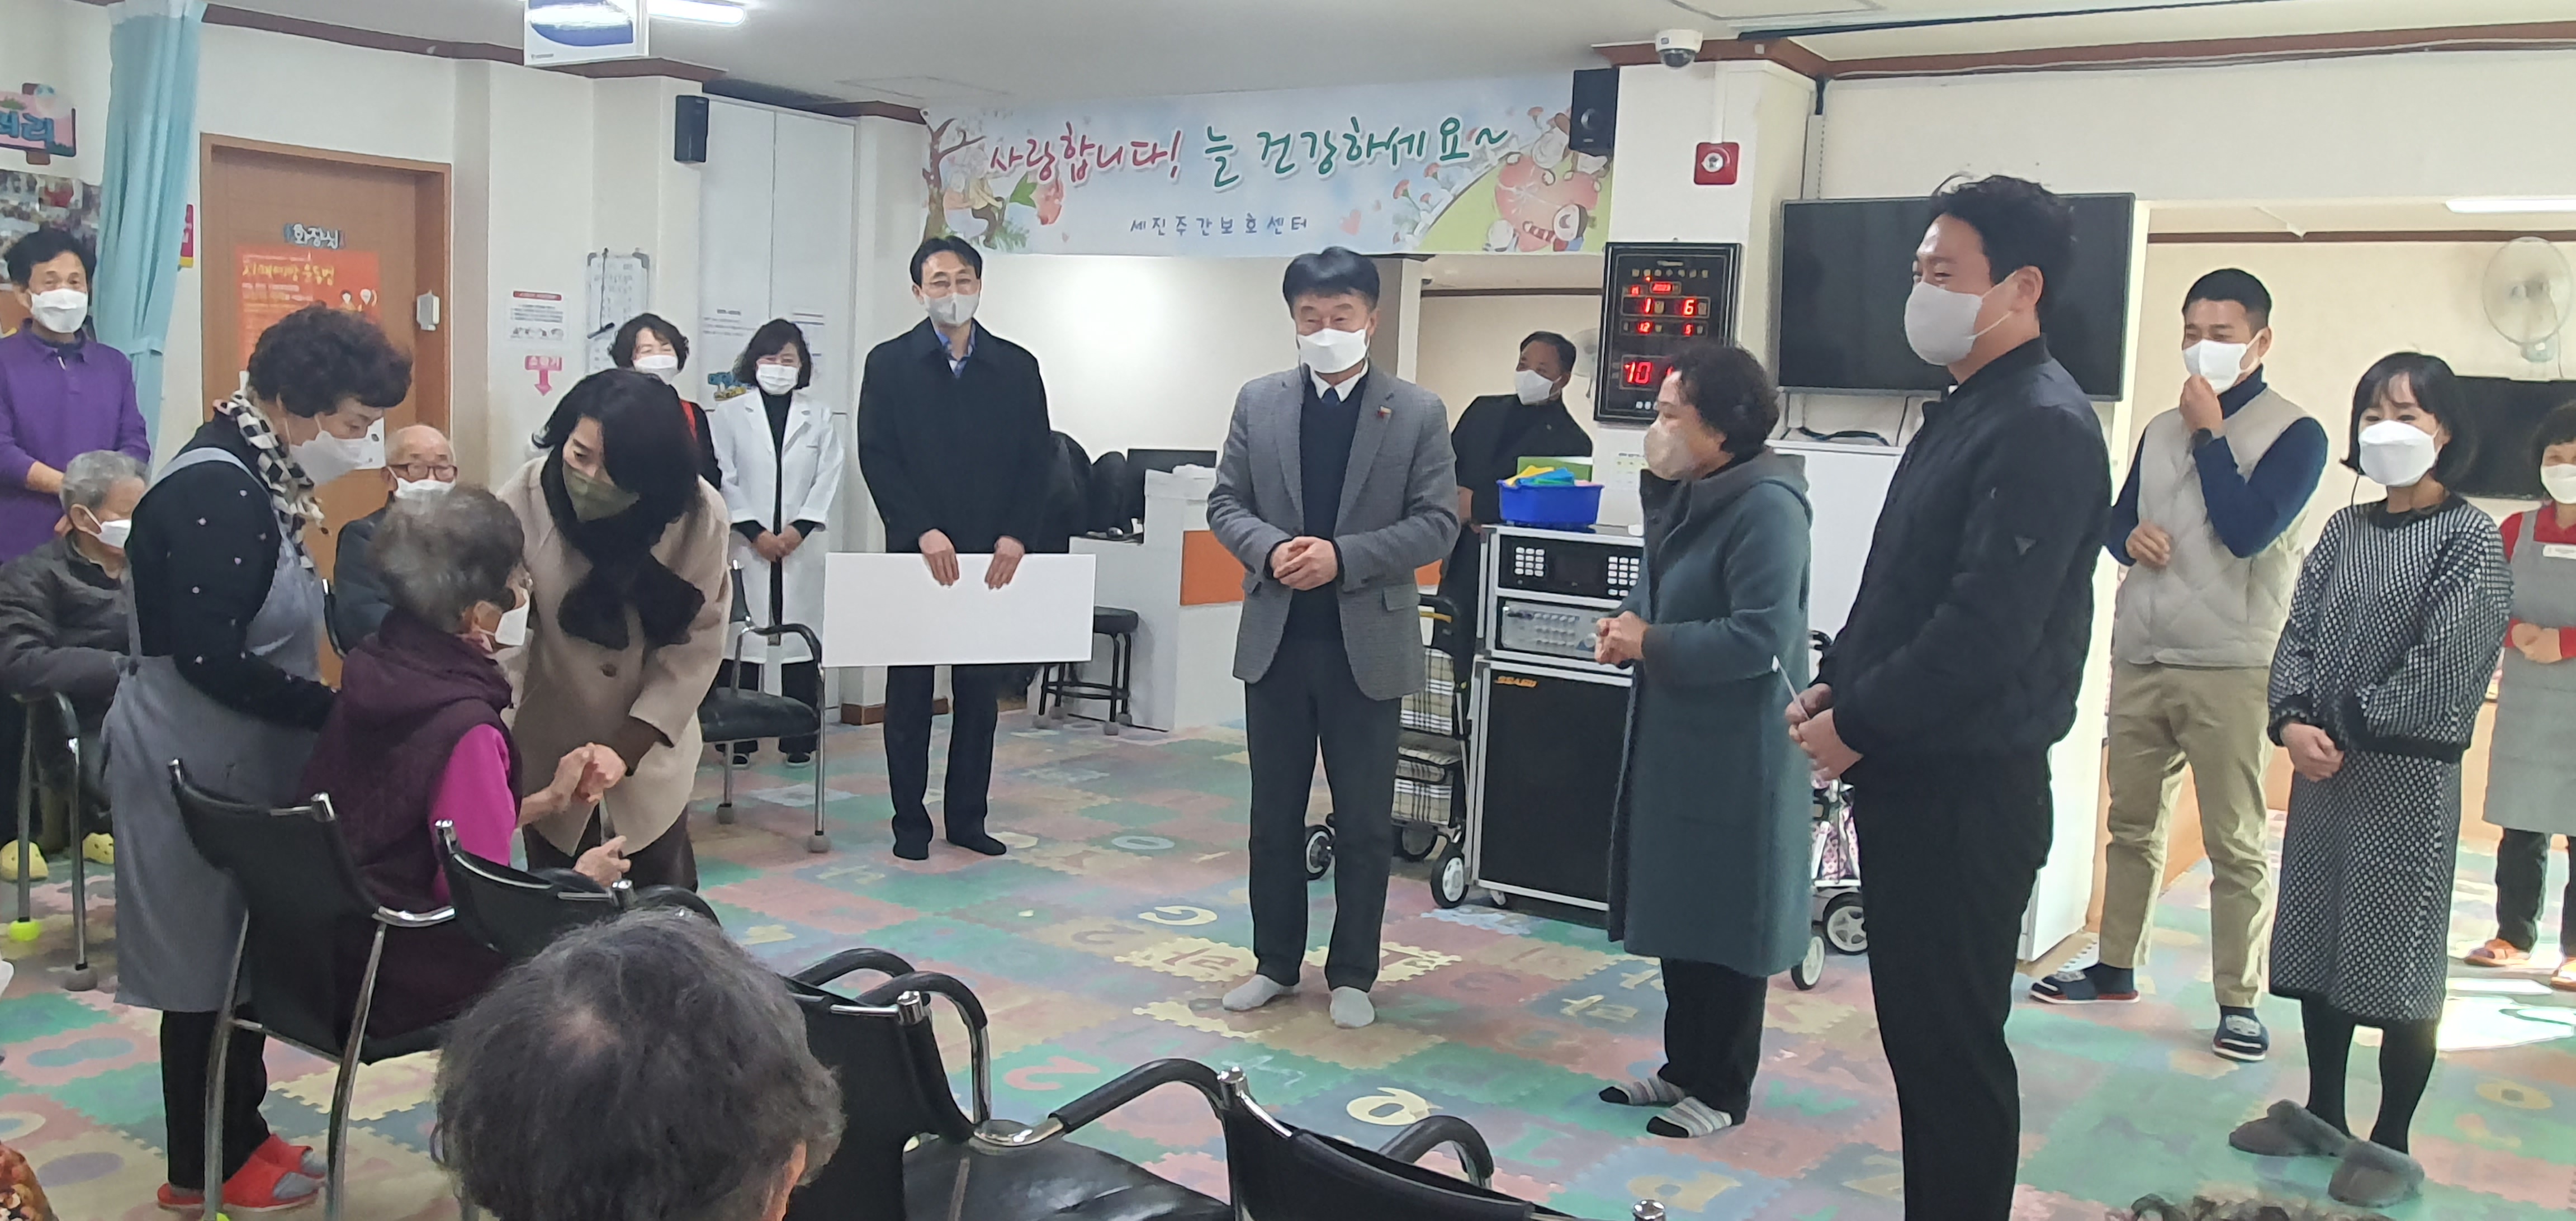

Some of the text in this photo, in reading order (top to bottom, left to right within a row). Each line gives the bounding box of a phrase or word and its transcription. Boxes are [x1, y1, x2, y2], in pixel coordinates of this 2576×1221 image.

[989, 116, 1508, 188] 사랑합니다! 늘 건강하세요~
[292, 223, 339, 249] 화장실
[1130, 212, 1307, 236] 세진주간보호센터
[1645, 297, 1652, 314] 1
[1683, 298, 1695, 316] 6
[1624, 361, 1652, 384] 10
